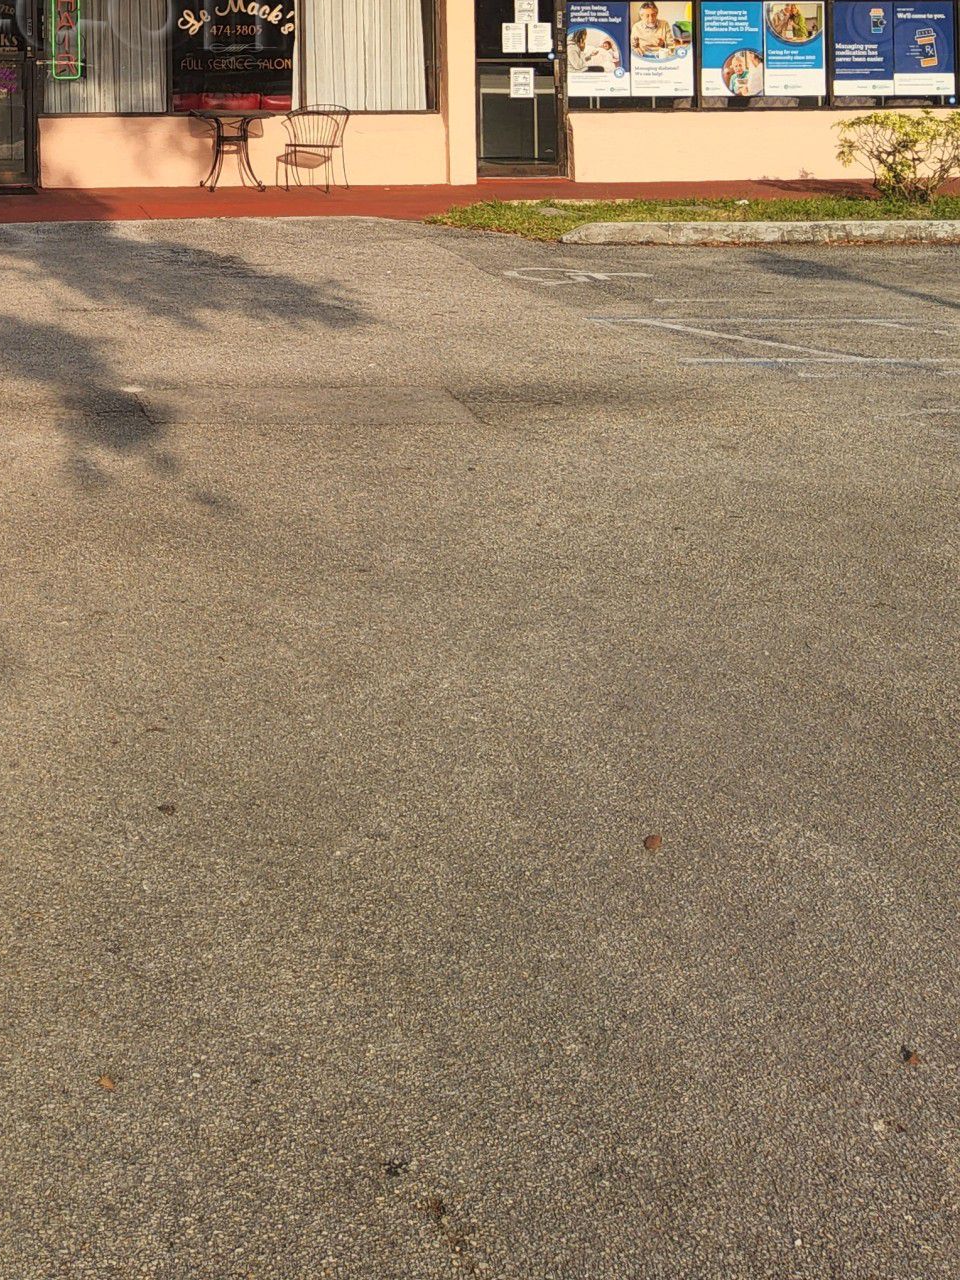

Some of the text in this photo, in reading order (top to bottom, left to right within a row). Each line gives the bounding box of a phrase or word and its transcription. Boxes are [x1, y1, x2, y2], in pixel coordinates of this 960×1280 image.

[180, 58, 292, 71] FULL SERVICE SALON
